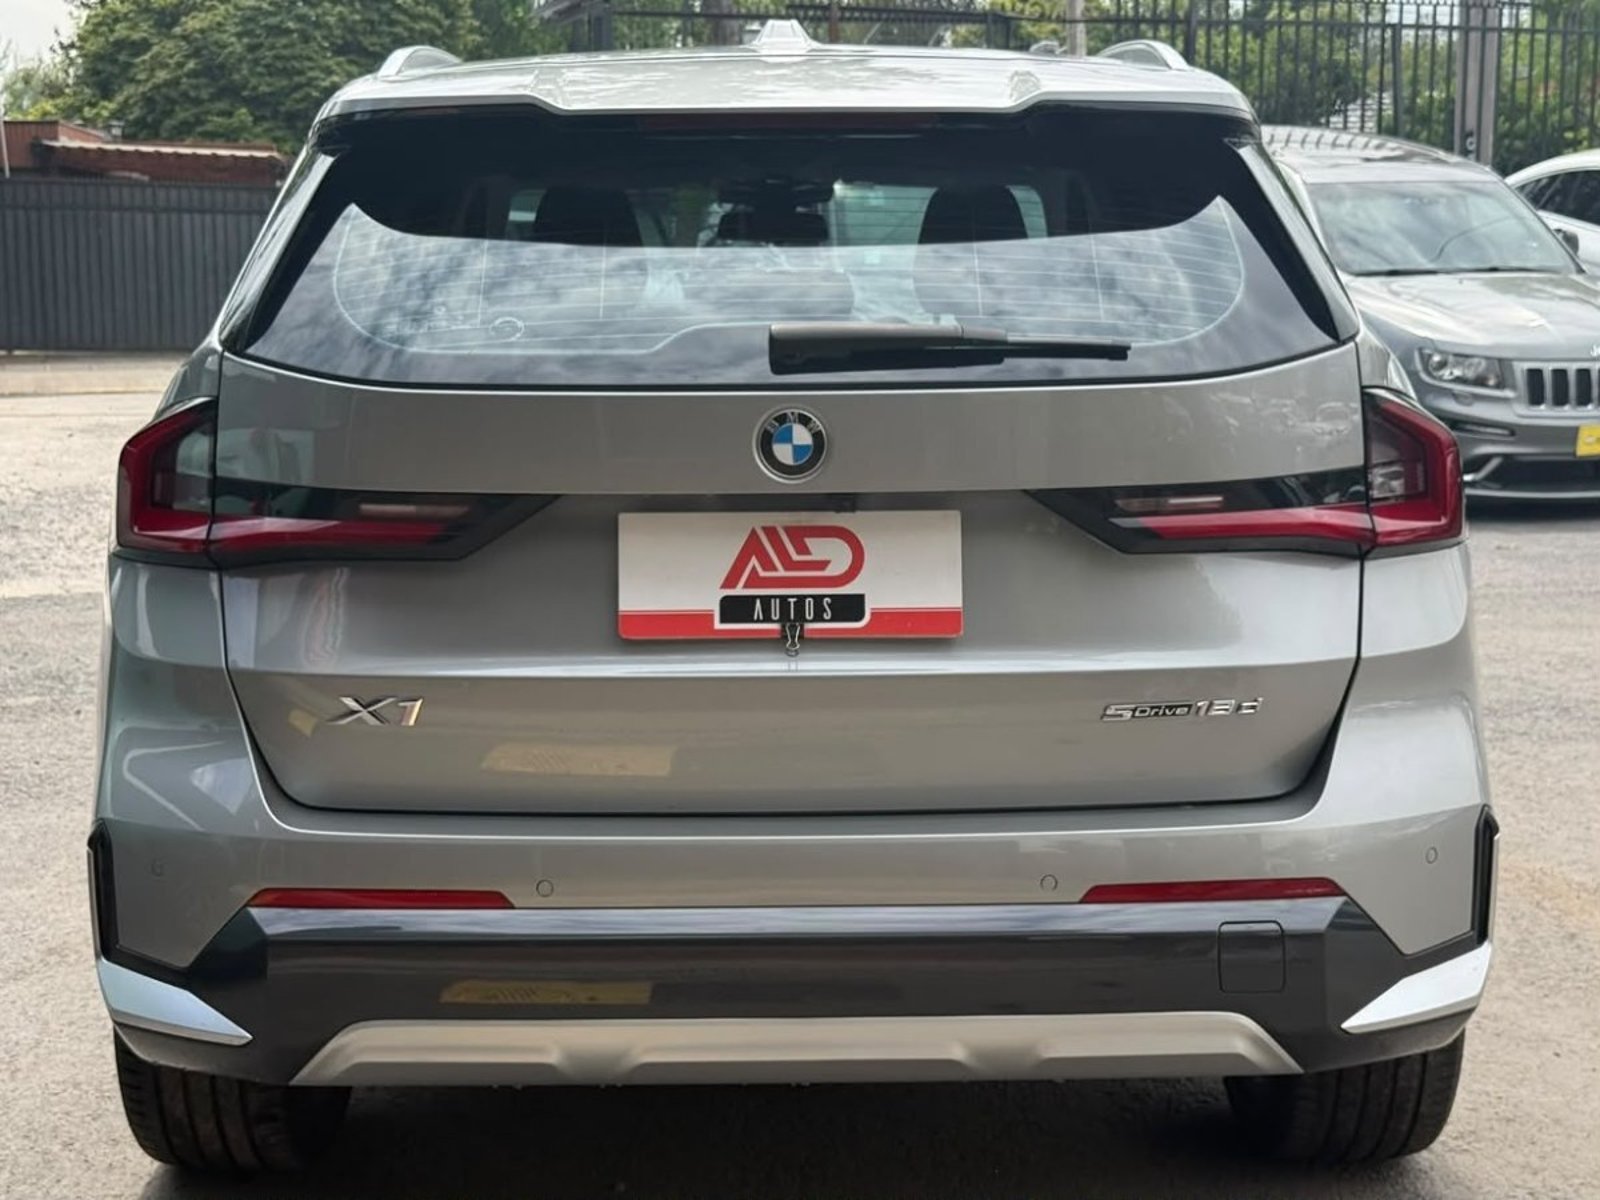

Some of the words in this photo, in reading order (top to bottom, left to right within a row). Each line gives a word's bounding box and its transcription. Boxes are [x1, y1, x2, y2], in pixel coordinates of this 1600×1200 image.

[763, 410, 822, 434] BMW
[753, 598, 832, 621] AUTOS
[327, 696, 424, 726] X1
